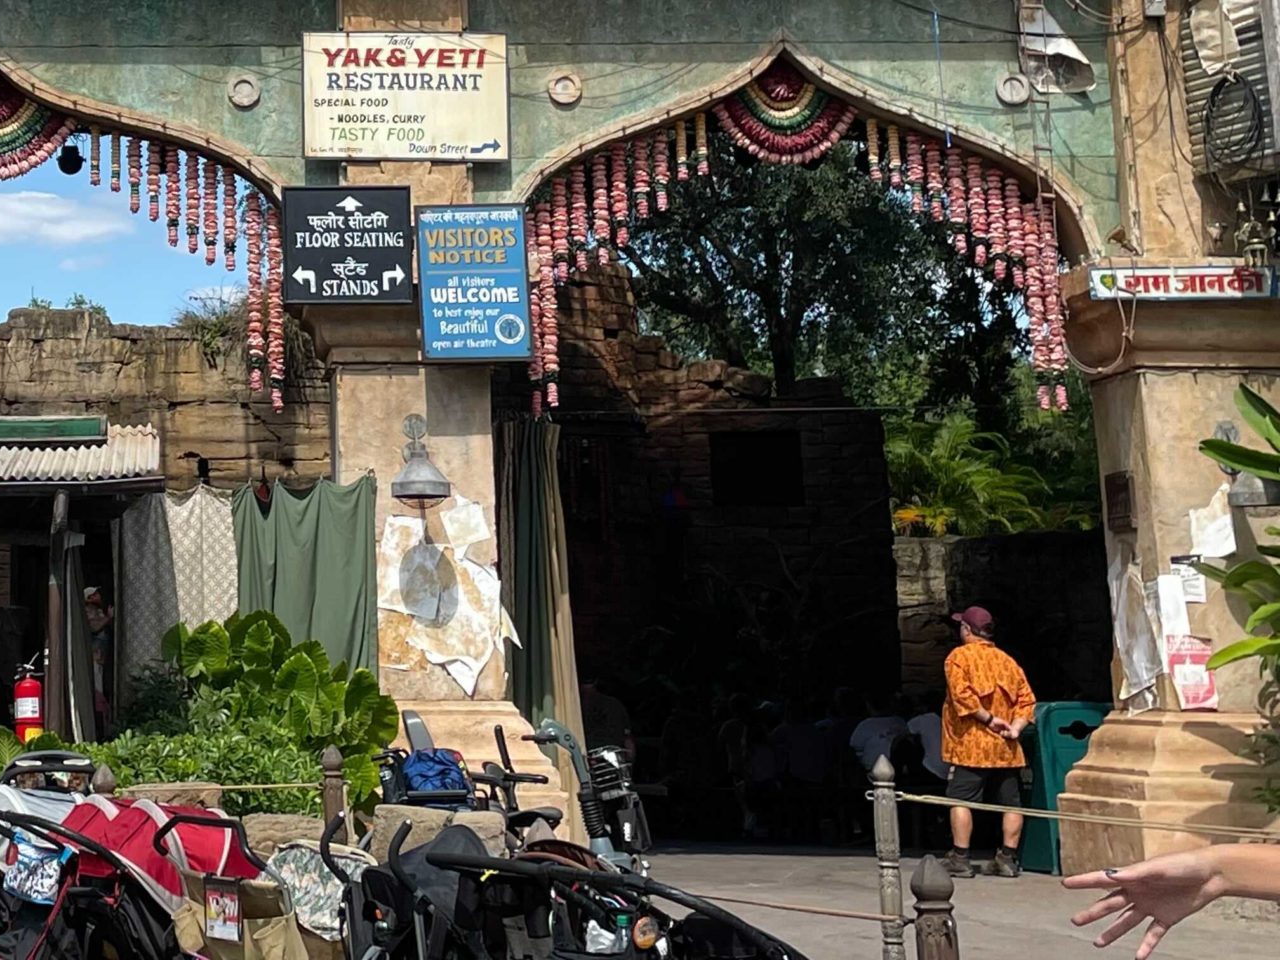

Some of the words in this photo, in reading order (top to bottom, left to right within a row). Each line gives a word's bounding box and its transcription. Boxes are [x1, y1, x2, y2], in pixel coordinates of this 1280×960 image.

[326, 71, 483, 92] RESTAURANT
[313, 98, 356, 108] SPECIAL
[360, 98, 389, 108] FOOD
[392, 114, 426, 124] CURRY
[329, 127, 380, 142] TASTY
[387, 127, 425, 142] FOOD
[409, 143, 437, 154] Down
[440, 143, 469, 154] Street
[295, 232, 341, 248] FLOOR
[345, 232, 404, 248] SEATING
[425, 227, 517, 248] VISITORS
[429, 249, 508, 265] NOTICE
[322, 278, 380, 297] STANDS
[447, 276, 460, 287] all
[462, 276, 496, 287] visitors
[431, 287, 520, 304] WELCOME
[432, 307, 443, 318] to
[485, 308, 500, 317] our
[439, 320, 489, 336] Beautiful
[453, 339, 465, 348] air
[466, 338, 497, 348] theatre
